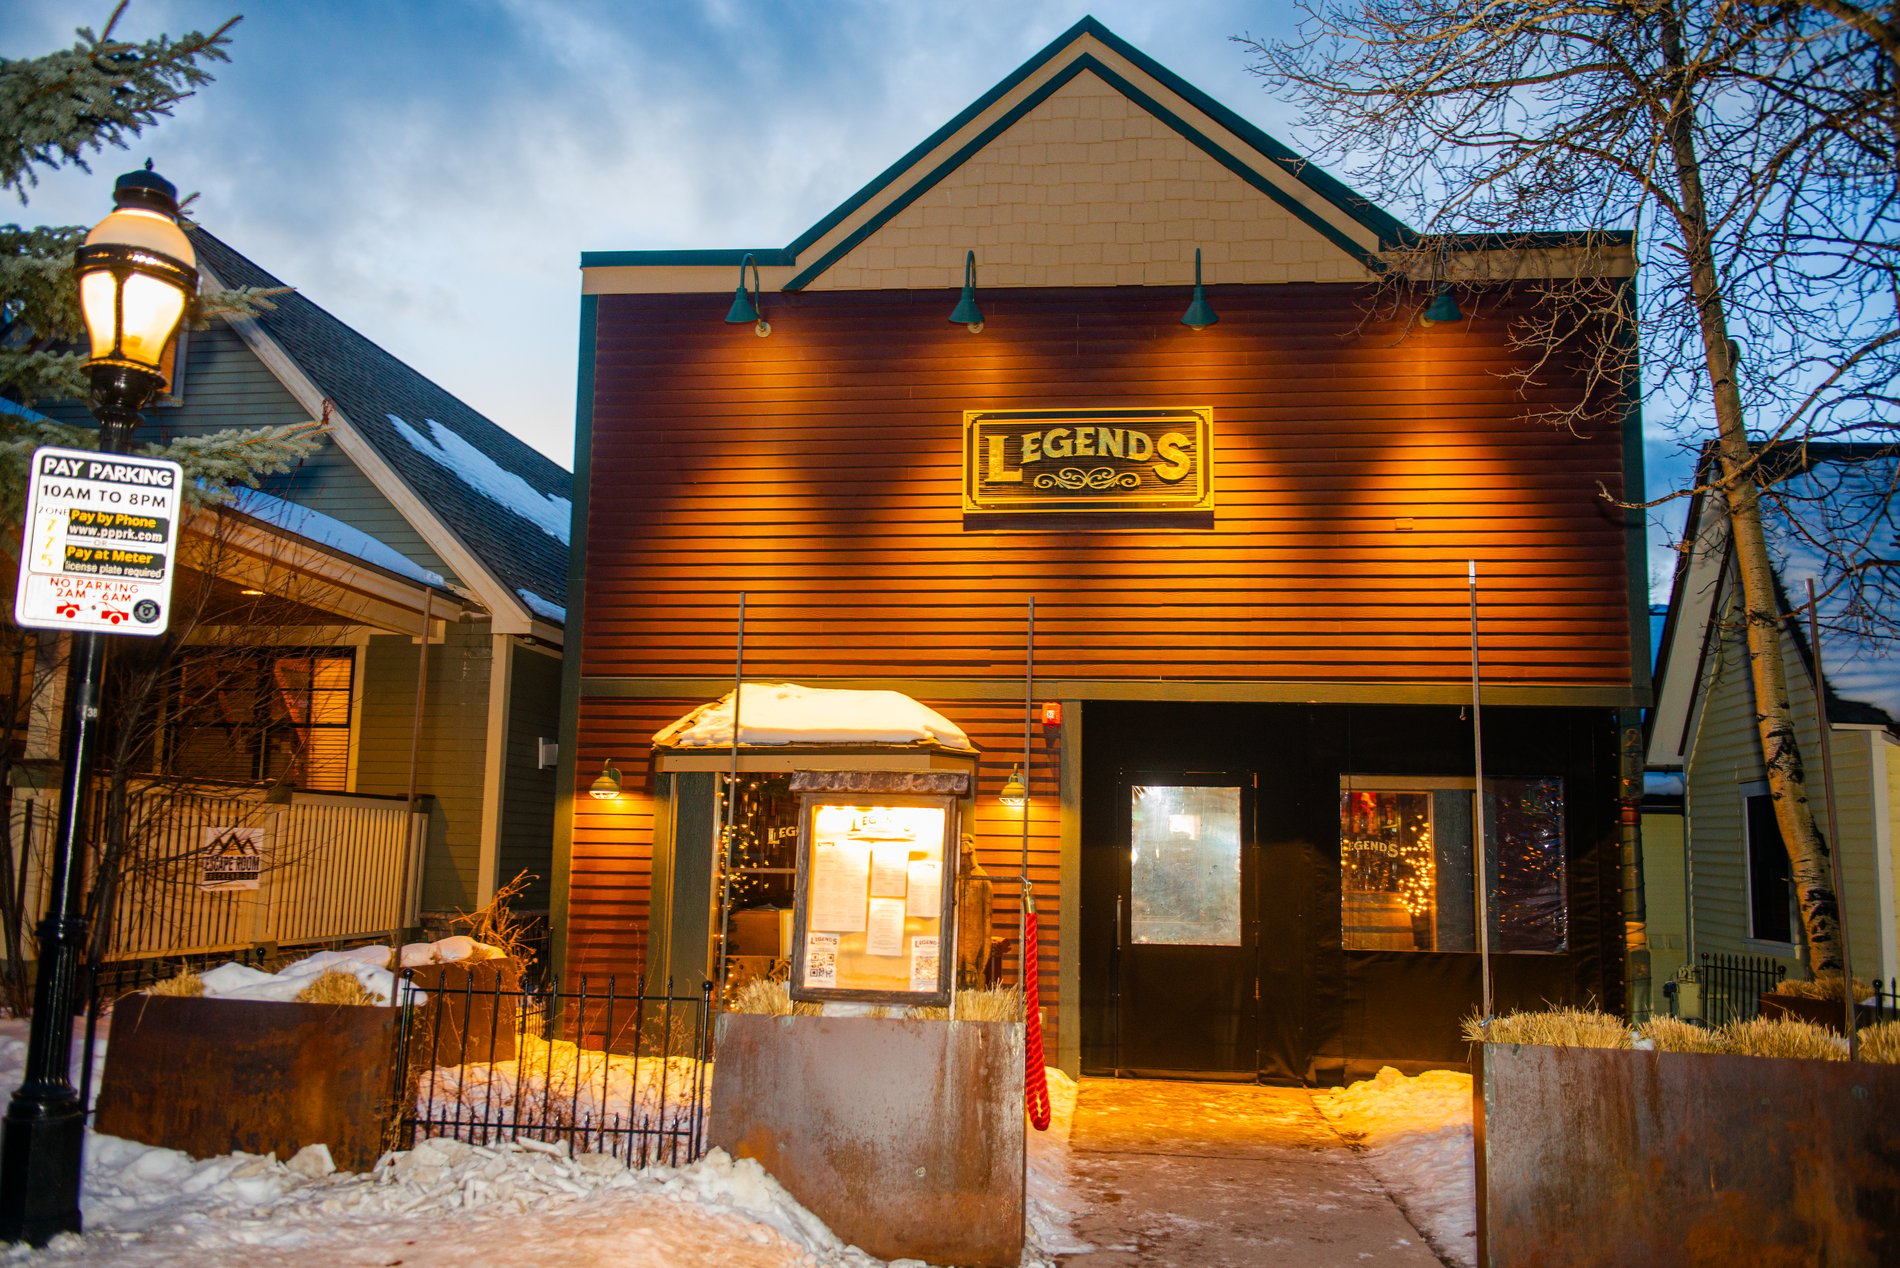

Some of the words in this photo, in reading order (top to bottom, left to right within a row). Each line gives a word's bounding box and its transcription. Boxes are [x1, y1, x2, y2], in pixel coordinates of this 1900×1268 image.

[983, 426, 1193, 483] LEGENDS
[43, 457, 84, 477] PAY
[89, 462, 173, 486] PARKING
[43, 484, 91, 500] 10AM
[99, 490, 122, 503] TO
[129, 493, 166, 508] 8PM
[38, 506, 69, 516] ZONE
[71, 509, 96, 525] Pay
[97, 511, 114, 527] by
[115, 514, 157, 529] Phone
[68, 525, 163, 542] www.ppprk.com
[66, 545, 92, 561] Pay
[94, 549, 110, 561] at
[112, 550, 153, 564] Meter
[64, 560, 98, 573] license
[99, 563, 122, 576] plate
[124, 566, 162, 579] required
[50, 577, 71, 588] NO
[76, 579, 139, 593] PARKING
[56, 587, 86, 598] 2AM
[101, 592, 131, 602] 6AM
[235, 856, 260, 871] ROOM
